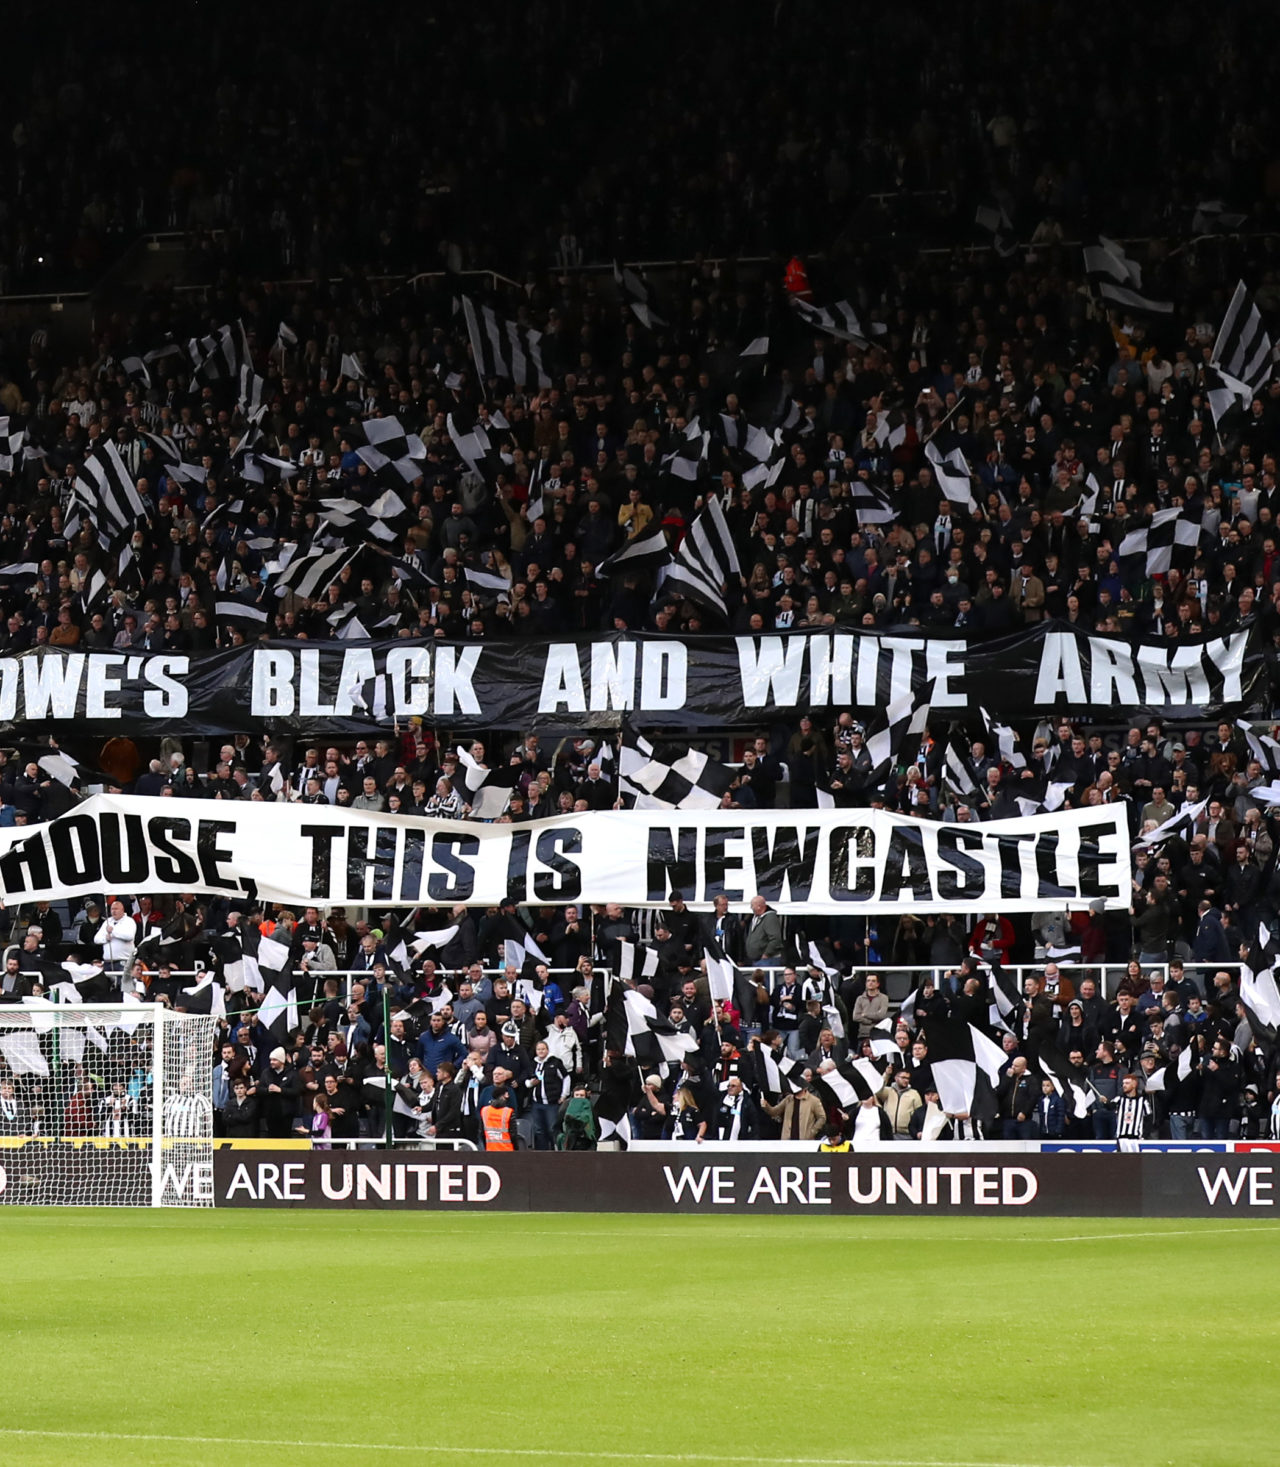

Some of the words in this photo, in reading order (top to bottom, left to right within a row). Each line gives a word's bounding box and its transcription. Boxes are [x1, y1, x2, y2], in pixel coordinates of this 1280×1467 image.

[251, 645, 483, 717] BLACK
[538, 640, 688, 714] AND
[735, 634, 968, 708] WHITE
[1034, 630, 1249, 706] ARMY
[300, 824, 480, 902] THIS
[506, 826, 583, 902] IS
[646, 822, 1120, 903] NEWCASTLE
[149, 1162, 214, 1200] WE
[225, 1163, 306, 1200] ARE
[320, 1163, 501, 1202] UNITED
[663, 1166, 736, 1204] WE
[747, 1166, 832, 1204] ARE
[848, 1166, 1038, 1205] UNITED
[1197, 1167, 1274, 1206] WE
